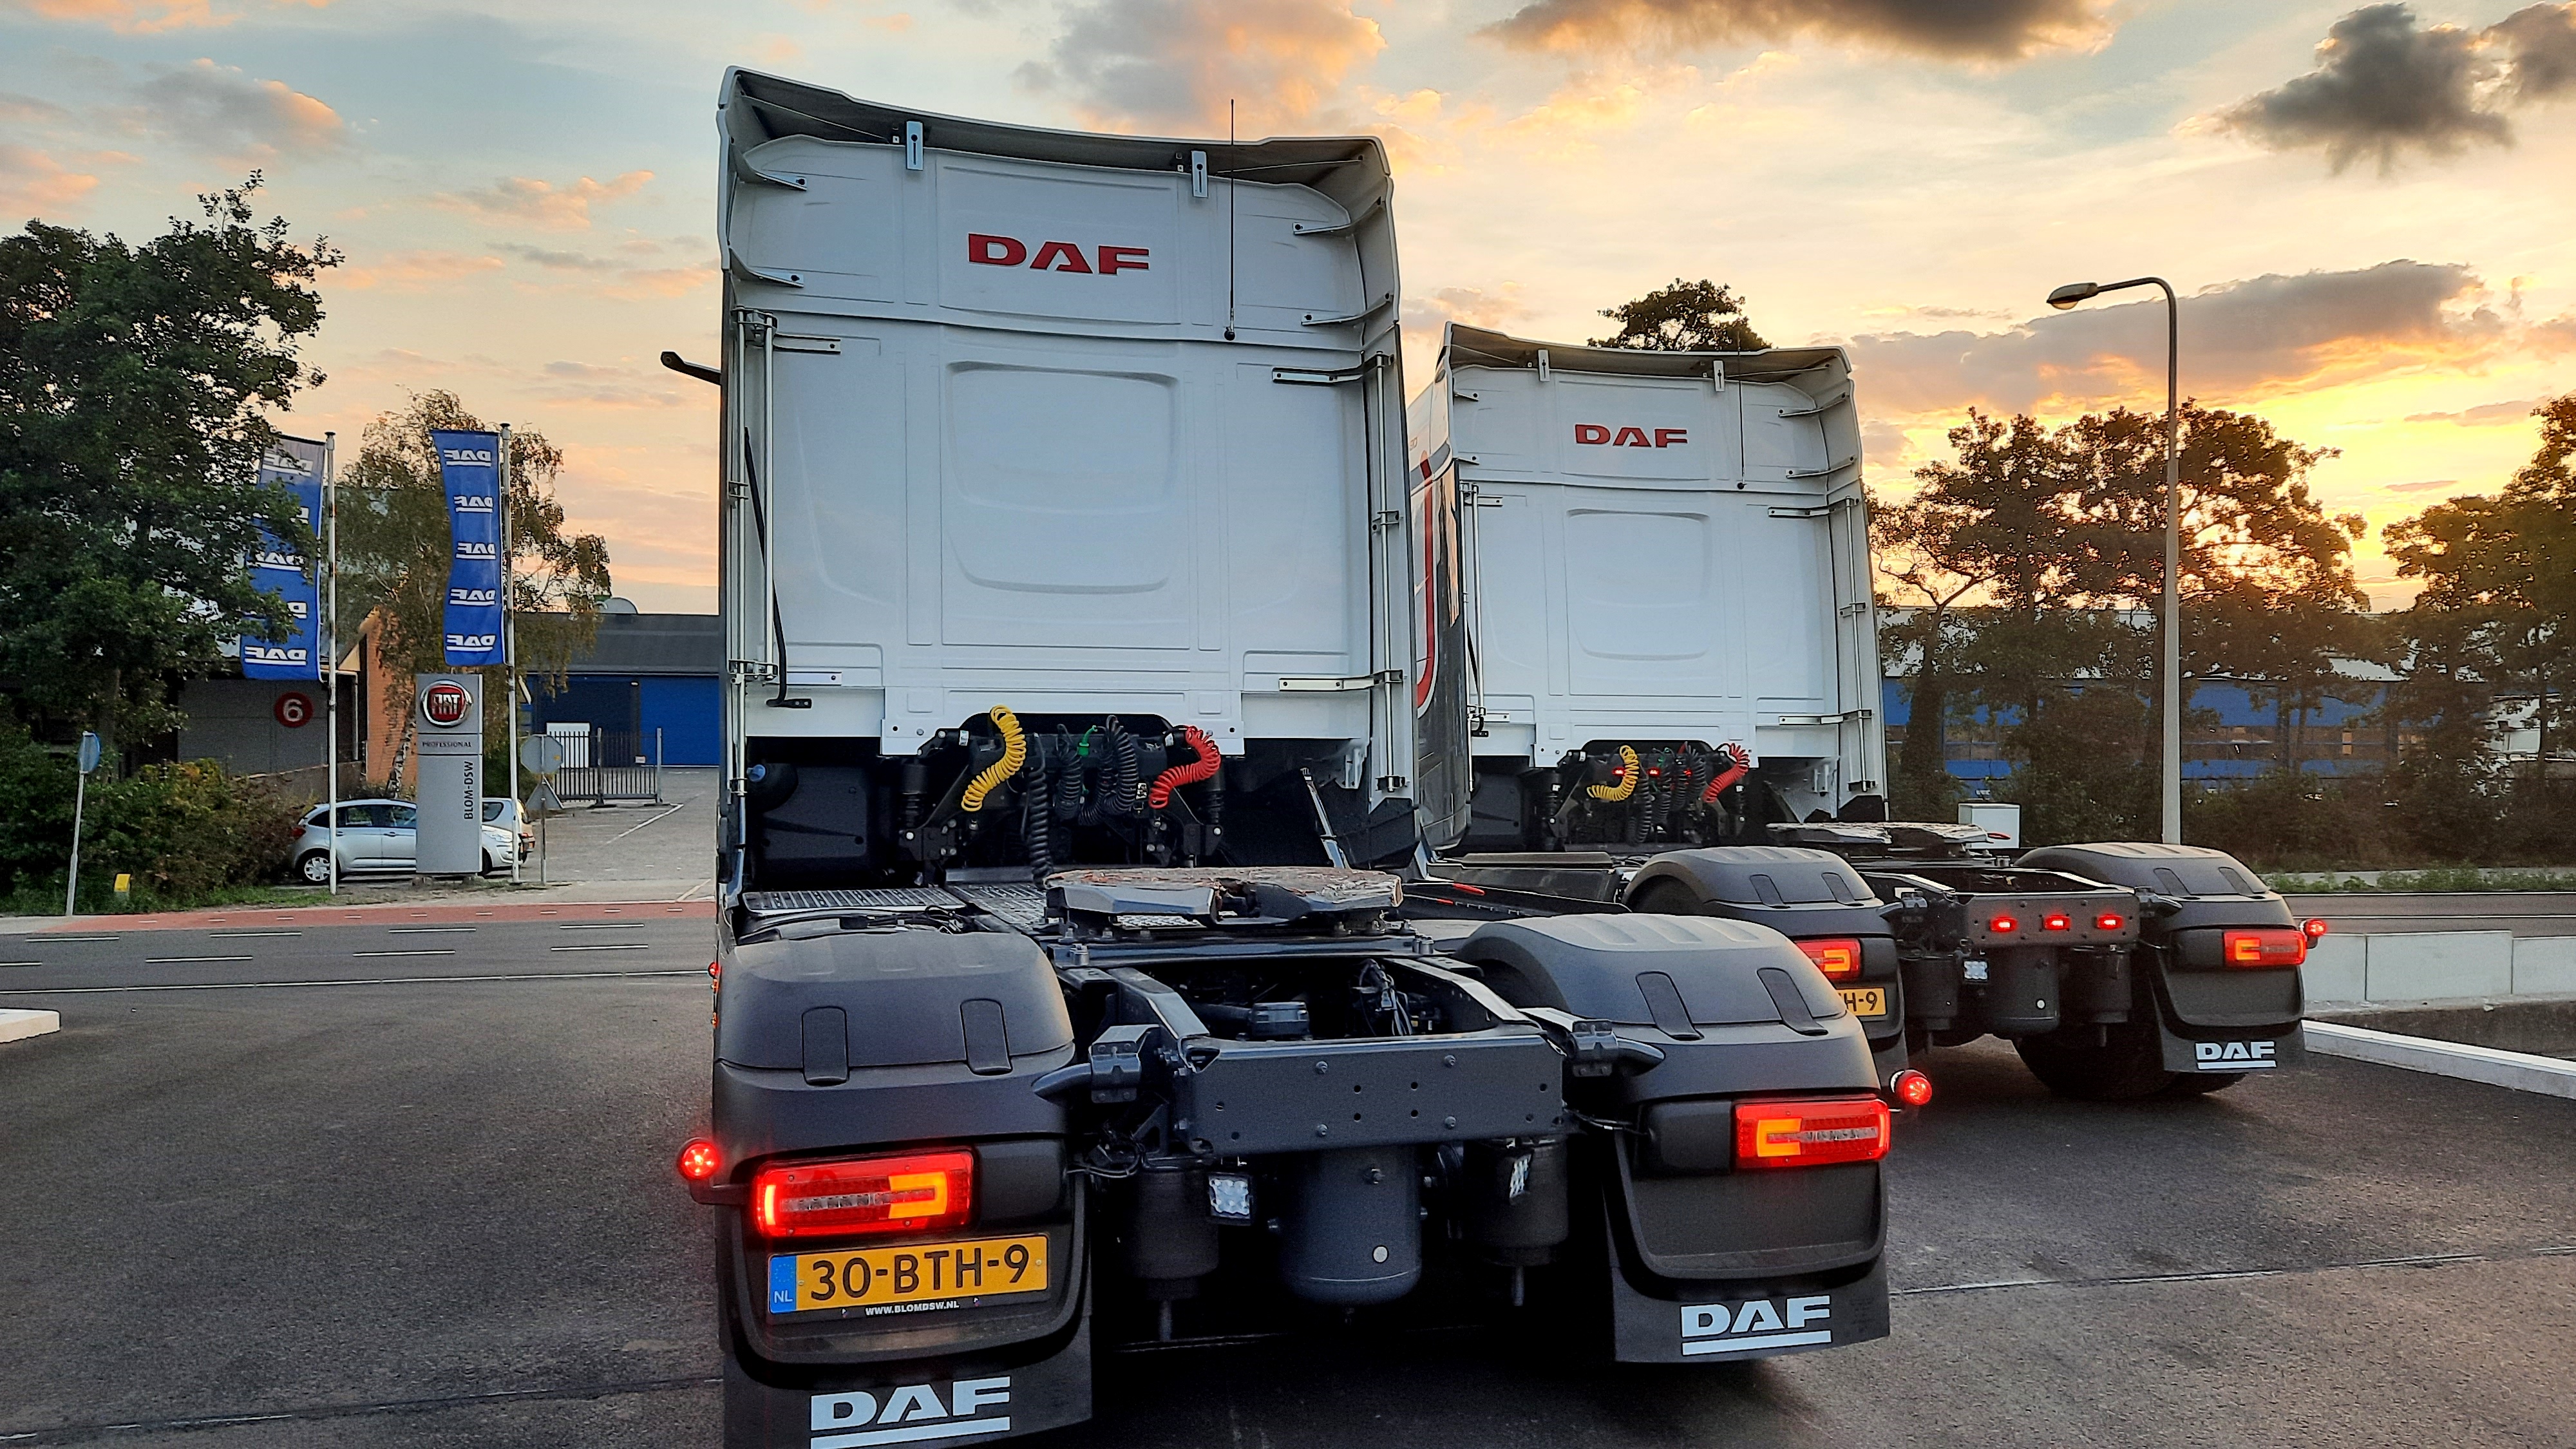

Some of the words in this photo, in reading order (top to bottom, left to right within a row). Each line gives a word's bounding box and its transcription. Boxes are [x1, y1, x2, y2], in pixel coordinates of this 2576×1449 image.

[968, 233, 1149, 275] DAF
[1575, 424, 1687, 448] DAF
[283, 699, 303, 722] 6
[431, 694, 460, 715] FIAT
[464, 761, 474, 820] BLOM-DSW
[1839, 991, 1878, 1012] H-9
[2195, 1041, 2275, 1061] DAF
[811, 1244, 1030, 1302] 30-BTH-9
[774, 1290, 793, 1304] NL
[865, 1300, 960, 1316] WWW.BLOMDSW.NL
[1681, 1295, 1830, 1338] DAF
[810, 1376, 1011, 1431] DAF
